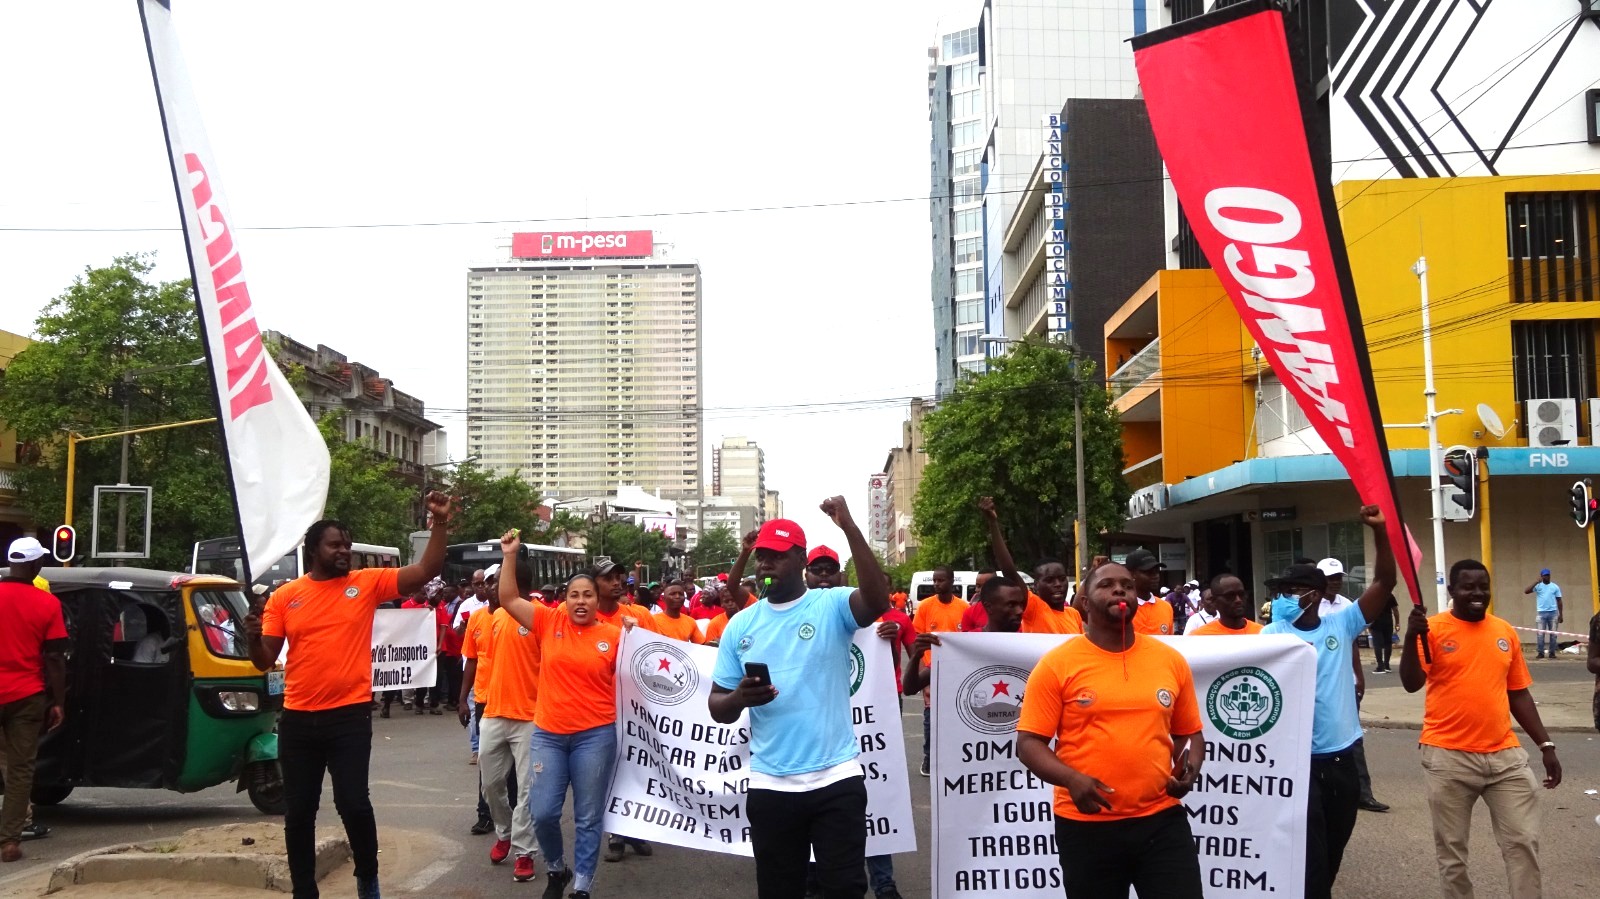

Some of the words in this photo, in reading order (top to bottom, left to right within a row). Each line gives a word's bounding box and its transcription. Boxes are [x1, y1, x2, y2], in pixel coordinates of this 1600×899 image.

[1049, 116, 1061, 181] BANCO
[1051, 195, 1062, 218] DE
[556, 234, 627, 253] m-pesa
[1529, 453, 1569, 467] FNB
[775, 529, 790, 538] YANGO
[378, 645, 387, 663] de
[388, 644, 428, 663] Transporte
[373, 668, 400, 688] Maputo
[857, 652, 865, 683] Humanos
[1208, 680, 1222, 721] Associação
[1220, 670, 1239, 681] Rede
[1255, 669, 1277, 690] Direitos
[1269, 690, 1281, 723] Humanos
[631, 699, 683, 737] YANGO
[853, 705, 876, 725] DE
[627, 720, 696, 768] COLOCAR
[704, 750, 742, 773] PÃO
[962, 739, 1019, 762] SOM
[1204, 741, 1275, 768] ANOS,
[626, 745, 714, 798] FAMÍLIAS,
[723, 777, 750, 795] NO
[1190, 773, 1294, 798] AMENTO
[646, 777, 694, 809] ESTES
[697, 803, 741, 820] TEM
[608, 796, 697, 834] ESTUDAR
[704, 822, 713, 839] E
[720, 828, 733, 843] A
[865, 813, 898, 837] ÃO.
[993, 801, 1052, 823] IGUA
[1184, 803, 1239, 825] MOS
[968, 834, 1060, 857] TRABAL
[1192, 835, 1260, 859] TADE.
[955, 867, 1061, 891] ARTIGOS
[1209, 868, 1275, 892] CRM.
